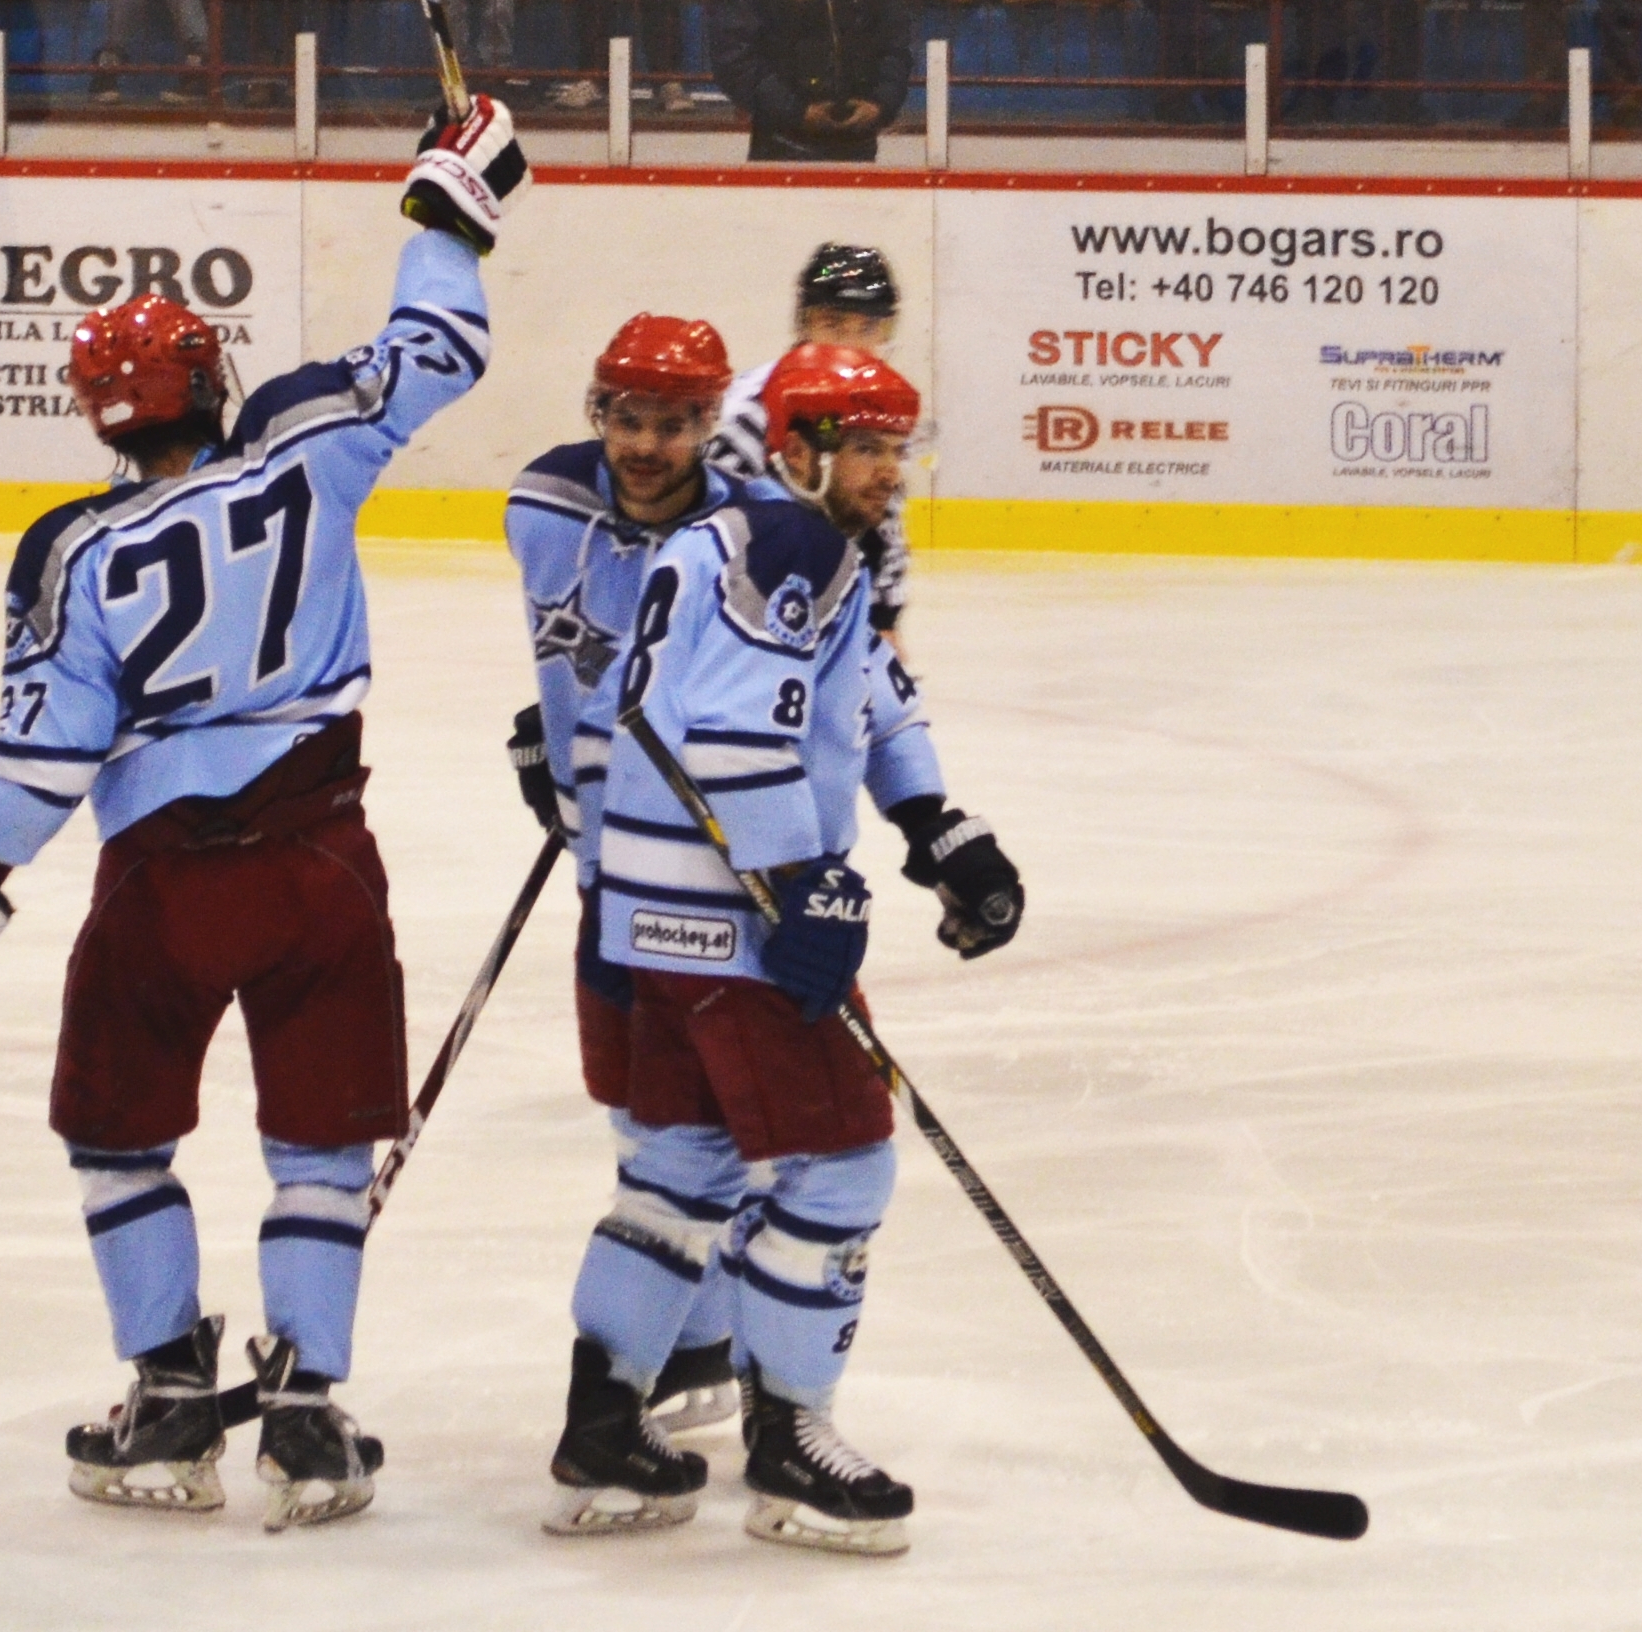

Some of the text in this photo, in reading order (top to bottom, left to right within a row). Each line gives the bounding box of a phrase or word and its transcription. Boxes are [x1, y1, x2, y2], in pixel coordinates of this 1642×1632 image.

[1071, 217, 1444, 267] www.bogars.ro
[1075, 271, 1440, 305] Tel: +40 746 120 120
[1028, 329, 1224, 368] STICKY
[1020, 373, 1231, 389] LAVABILE, VOPSELE, LACURI
[1460, 380, 1491, 393] PPR
[1110, 420, 1230, 441] RELEE
[1330, 400, 1489, 463] Coral
[1039, 460, 1211, 476] MATERIALE ELECTRICE
[102, 460, 314, 721] 27
[771, 677, 807, 730] 8
[634, 921, 731, 954] prohockey.at
